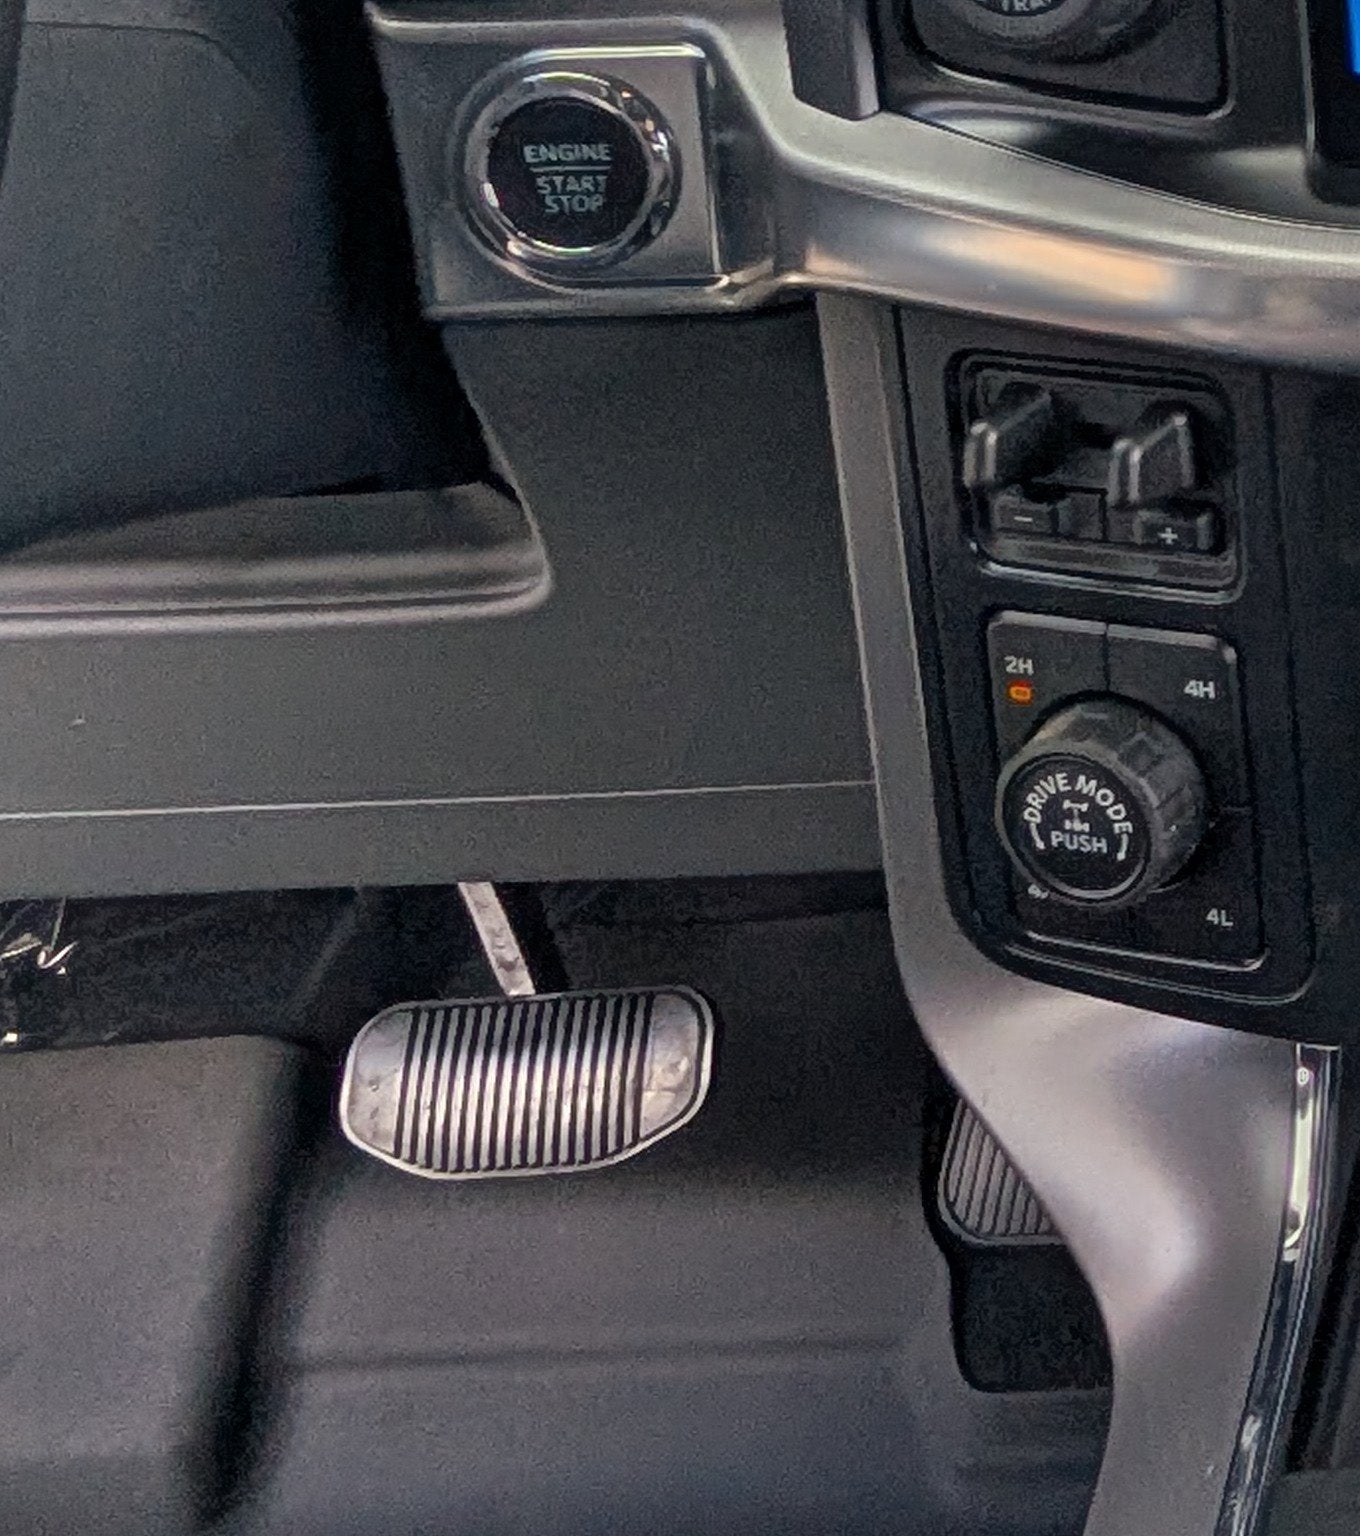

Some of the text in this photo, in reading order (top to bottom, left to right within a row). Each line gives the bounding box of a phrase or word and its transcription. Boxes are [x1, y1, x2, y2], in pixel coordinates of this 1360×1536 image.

[523, 143, 612, 163] ENGINE
[536, 175, 607, 195] START
[544, 195, 604, 213] STOP
[1004, 654, 1034, 676] 2H
[1183, 679, 1216, 699] 4H
[1023, 773, 1135, 834] DRIVE MODE
[1050, 829, 1108, 854] PUSH
[1205, 907, 1234, 927] 4L
